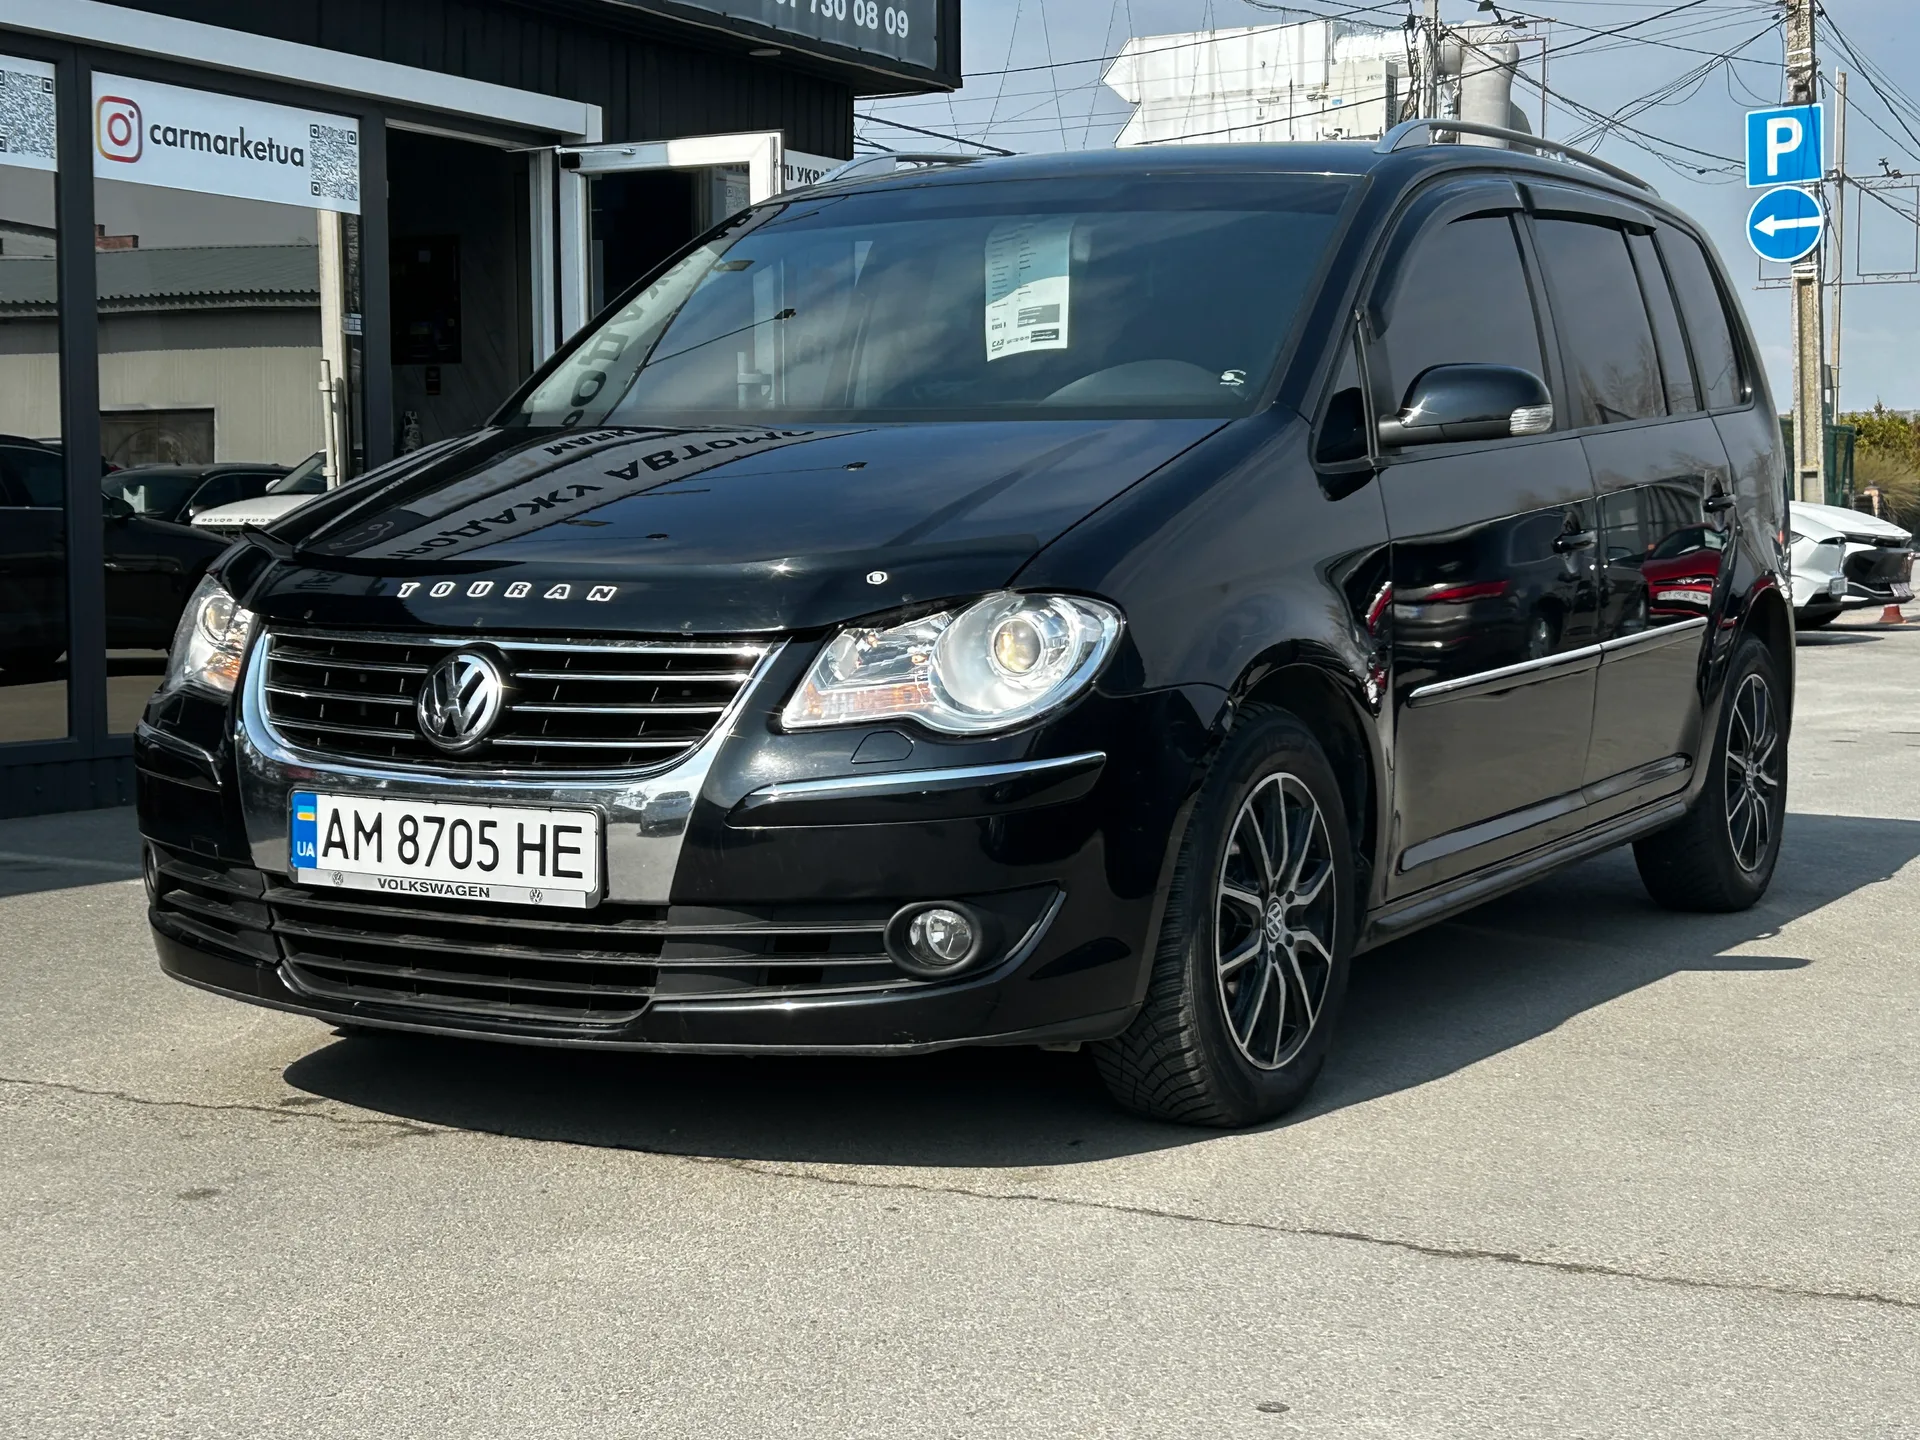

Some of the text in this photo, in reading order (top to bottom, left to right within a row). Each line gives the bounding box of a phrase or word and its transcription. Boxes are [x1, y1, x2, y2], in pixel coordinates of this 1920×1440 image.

[853, 0, 879, 30] 08
[885, 6, 909, 39] 09
[149, 123, 305, 168] carmarketua
[1766, 116, 1803, 176] P
[797, 166, 831, 185] УКР
[396, 581, 618, 601] TOURAN
[296, 841, 316, 858] UA
[321, 807, 584, 879] AM 8705 HE
[377, 877, 490, 898] VOLKSWAGEN
